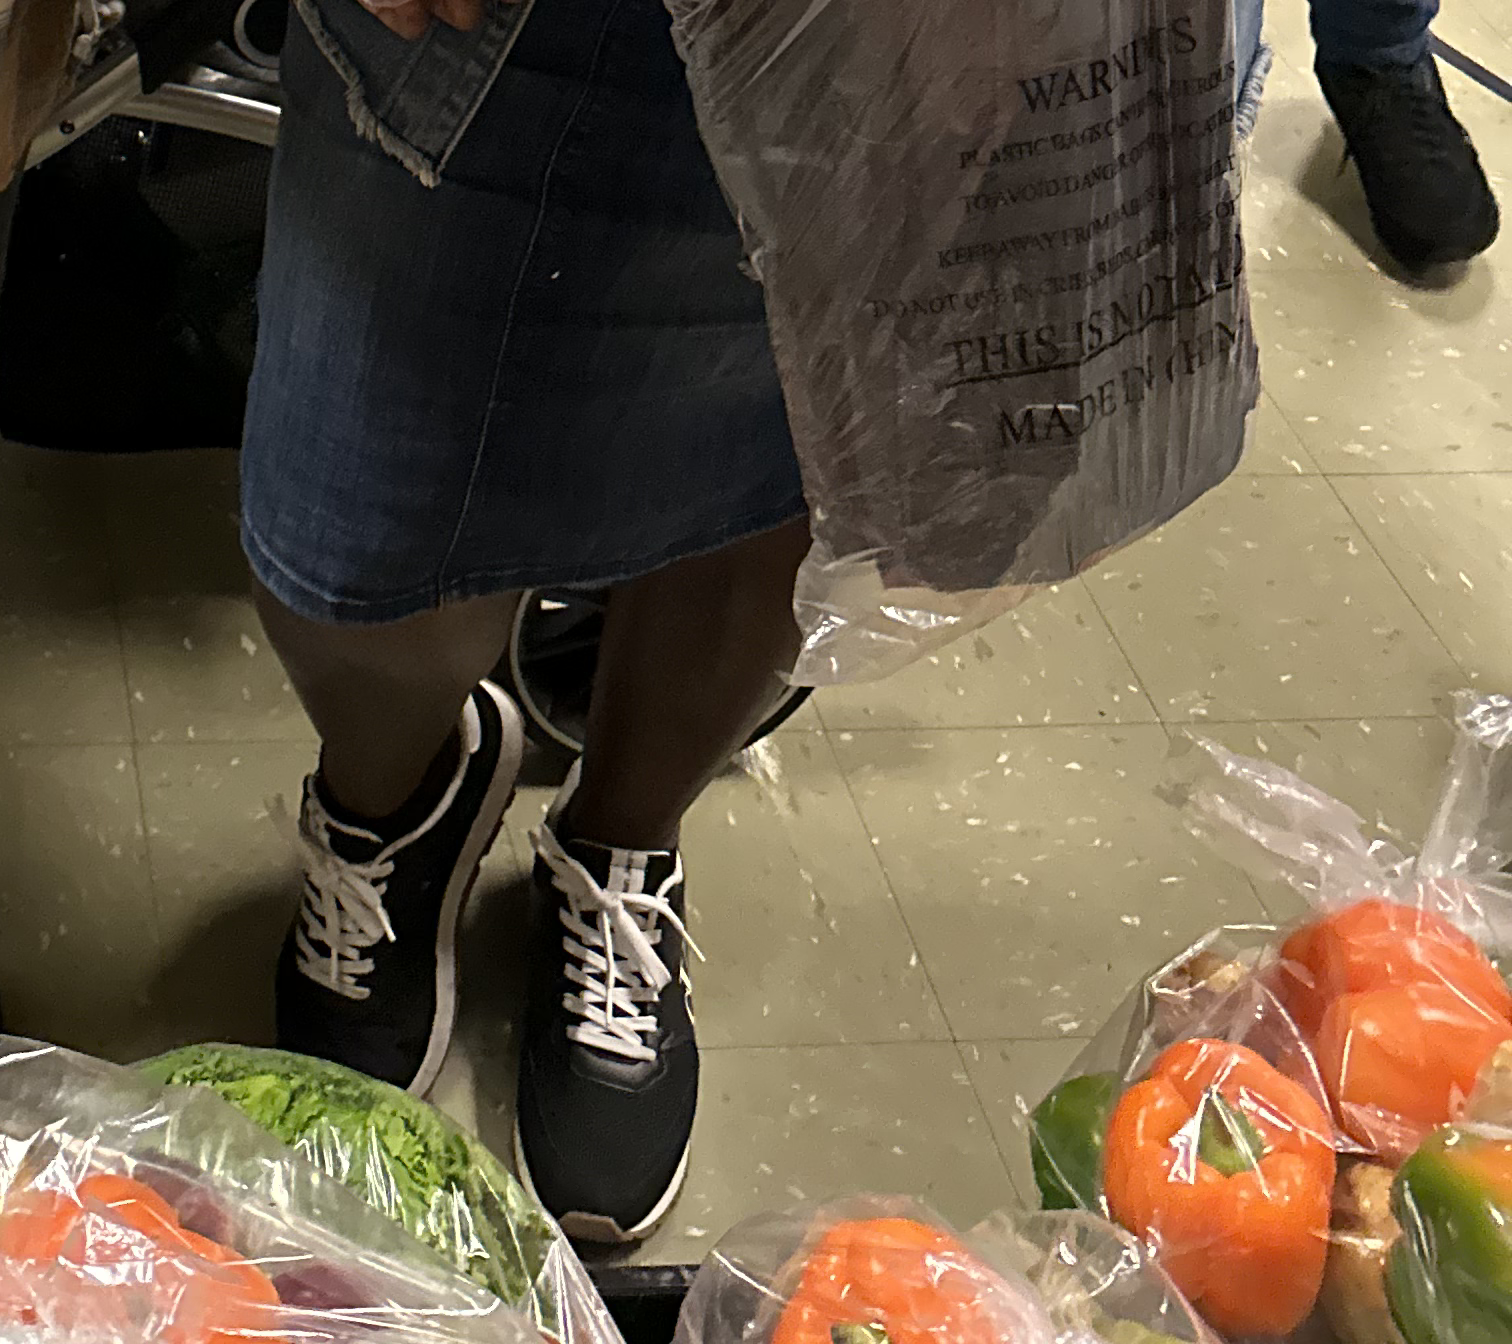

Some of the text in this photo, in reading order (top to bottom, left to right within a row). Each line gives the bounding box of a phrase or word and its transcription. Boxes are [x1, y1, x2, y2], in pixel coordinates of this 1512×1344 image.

[941, 324, 1062, 378] THIS
[1074, 310, 1104, 358] IS
[994, 378, 1117, 448] MADE
